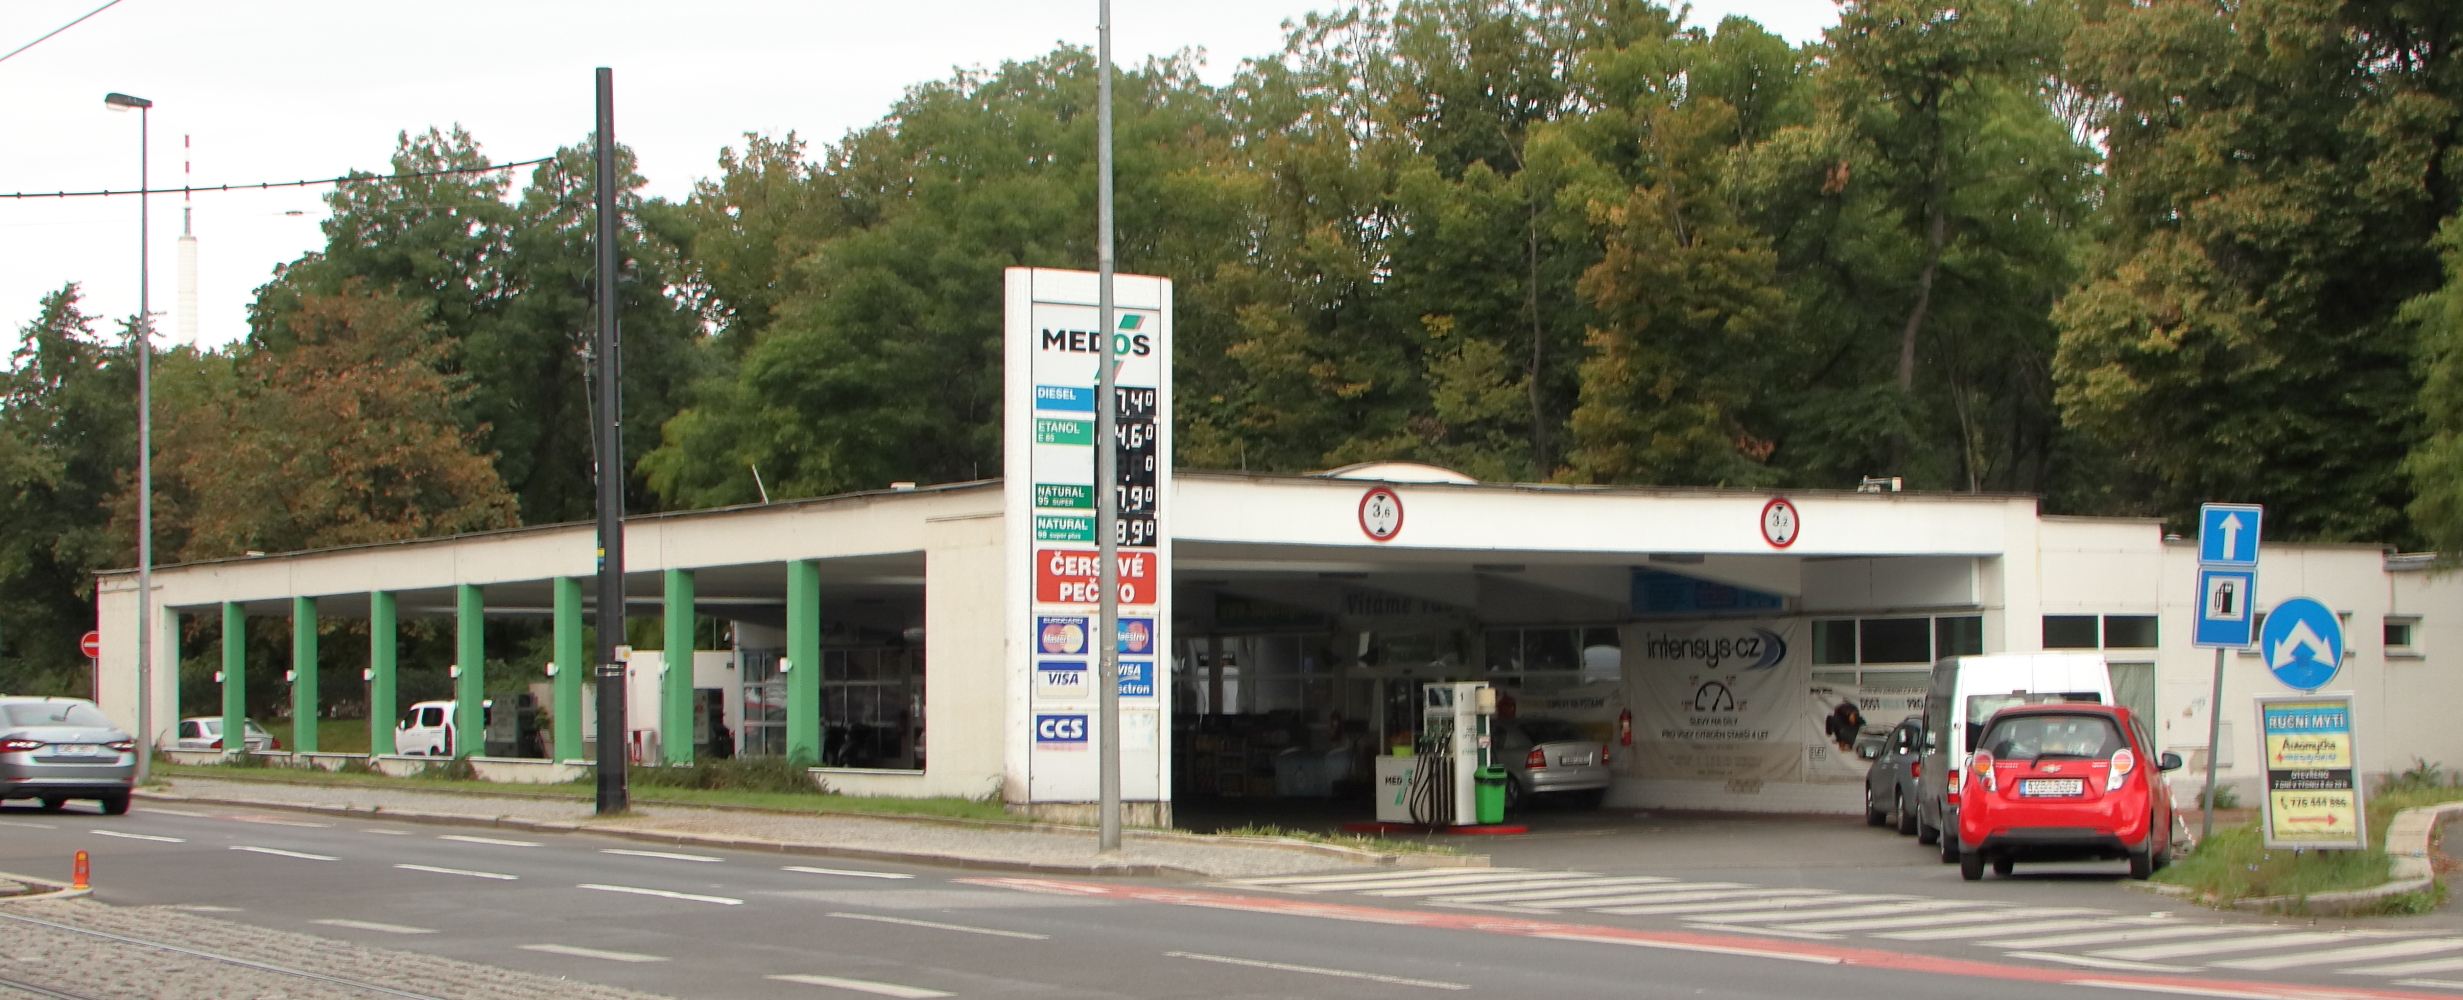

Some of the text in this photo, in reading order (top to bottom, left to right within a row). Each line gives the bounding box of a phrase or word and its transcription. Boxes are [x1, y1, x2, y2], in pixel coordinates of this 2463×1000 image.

[1037, 387, 1076, 401] DIESEL
[1038, 420, 1081, 434] ETANOL
[1038, 433, 1044, 442] E
[1038, 485, 1085, 498] NATURAL
[1038, 497, 1074, 507] 95 SUPER
[1038, 518, 1088, 531] NATURAL
[1038, 531, 1081, 541] 98 super plus
[1050, 551, 1144, 577] ČERSVÉ
[1060, 578, 1135, 603] PEČO
[1043, 634, 1083, 645] MasterCard
[1048, 673, 1079, 685] VISA
[1119, 683, 1150, 694] ectron
[2269, 712, 2310, 729] RUČNÍ
[1040, 718, 1083, 739] CCS
[1385, 775, 1413, 786] MEDS
